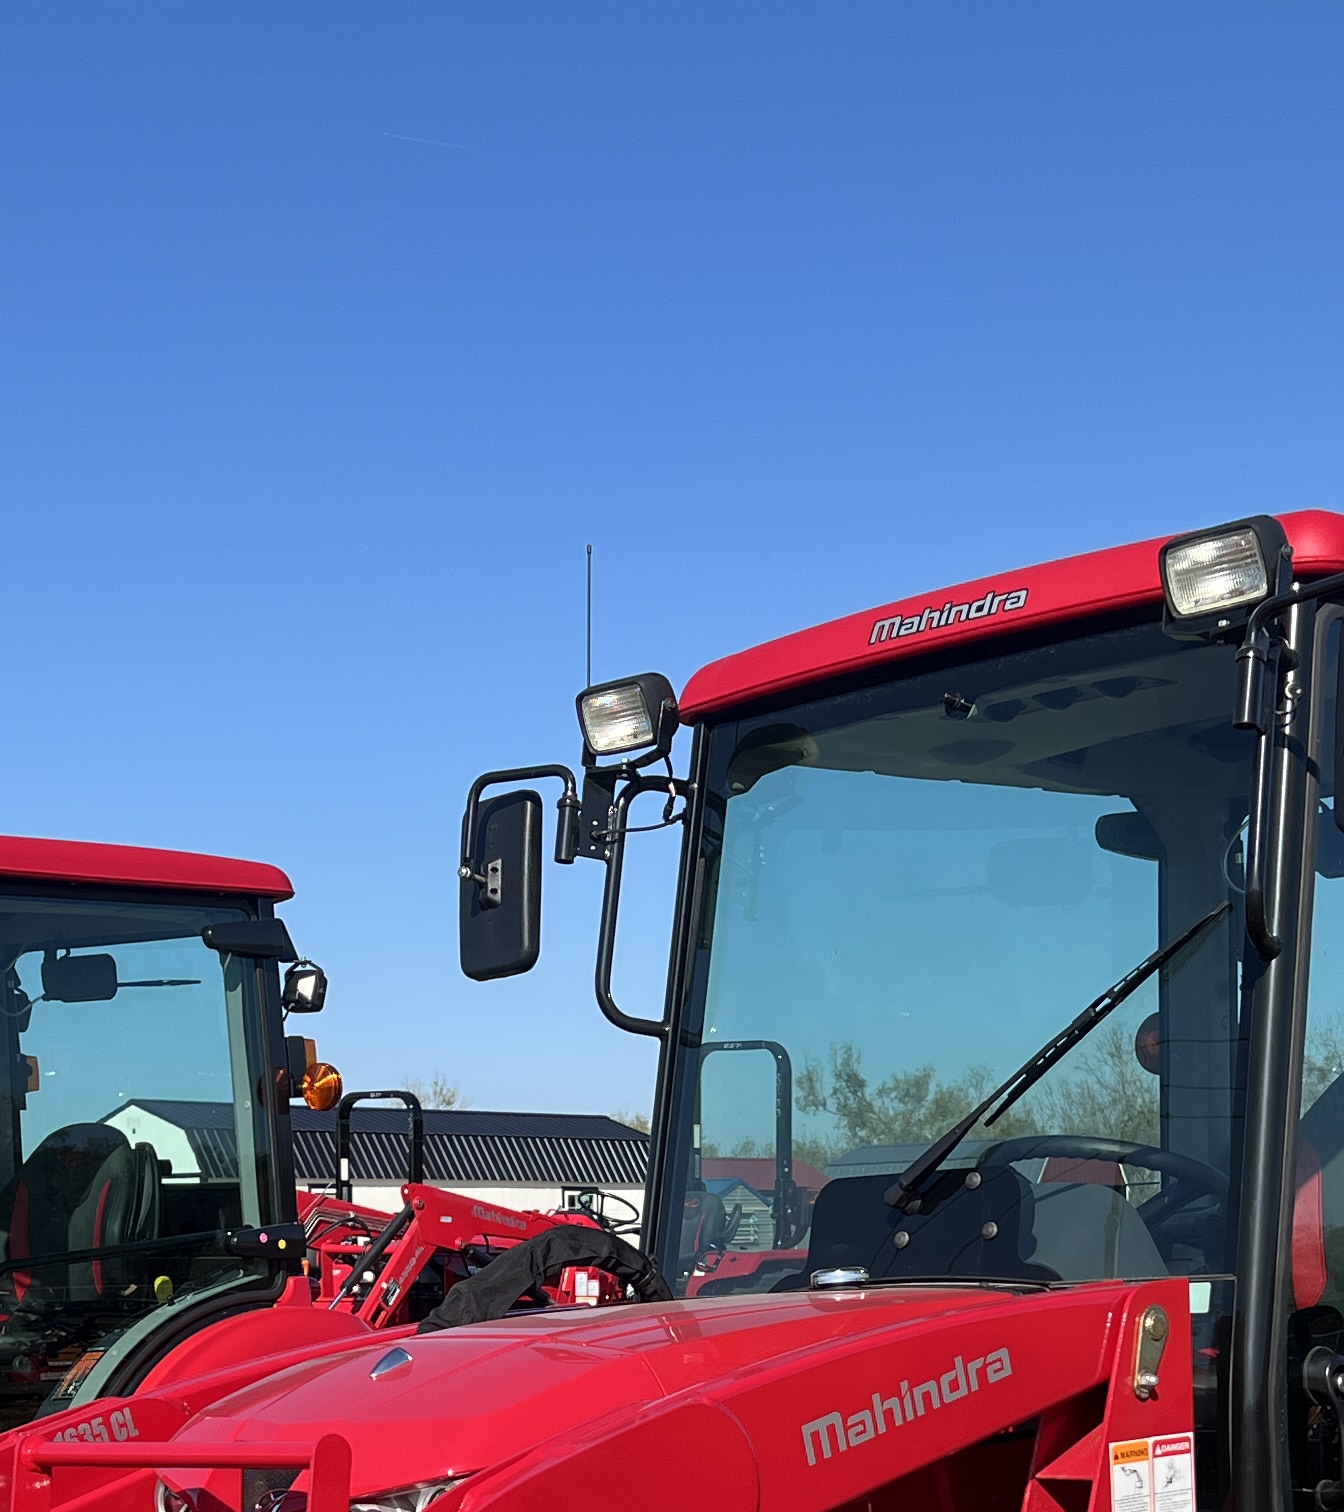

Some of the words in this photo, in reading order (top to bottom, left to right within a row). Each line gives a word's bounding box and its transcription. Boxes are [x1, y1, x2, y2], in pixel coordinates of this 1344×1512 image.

[868, 588, 1029, 645] Mahindra
[801, 1347, 1012, 1466] Mahindra
[1121, 1447, 1149, 1459] WARNING
[1161, 1442, 1190, 1453] DANGER
